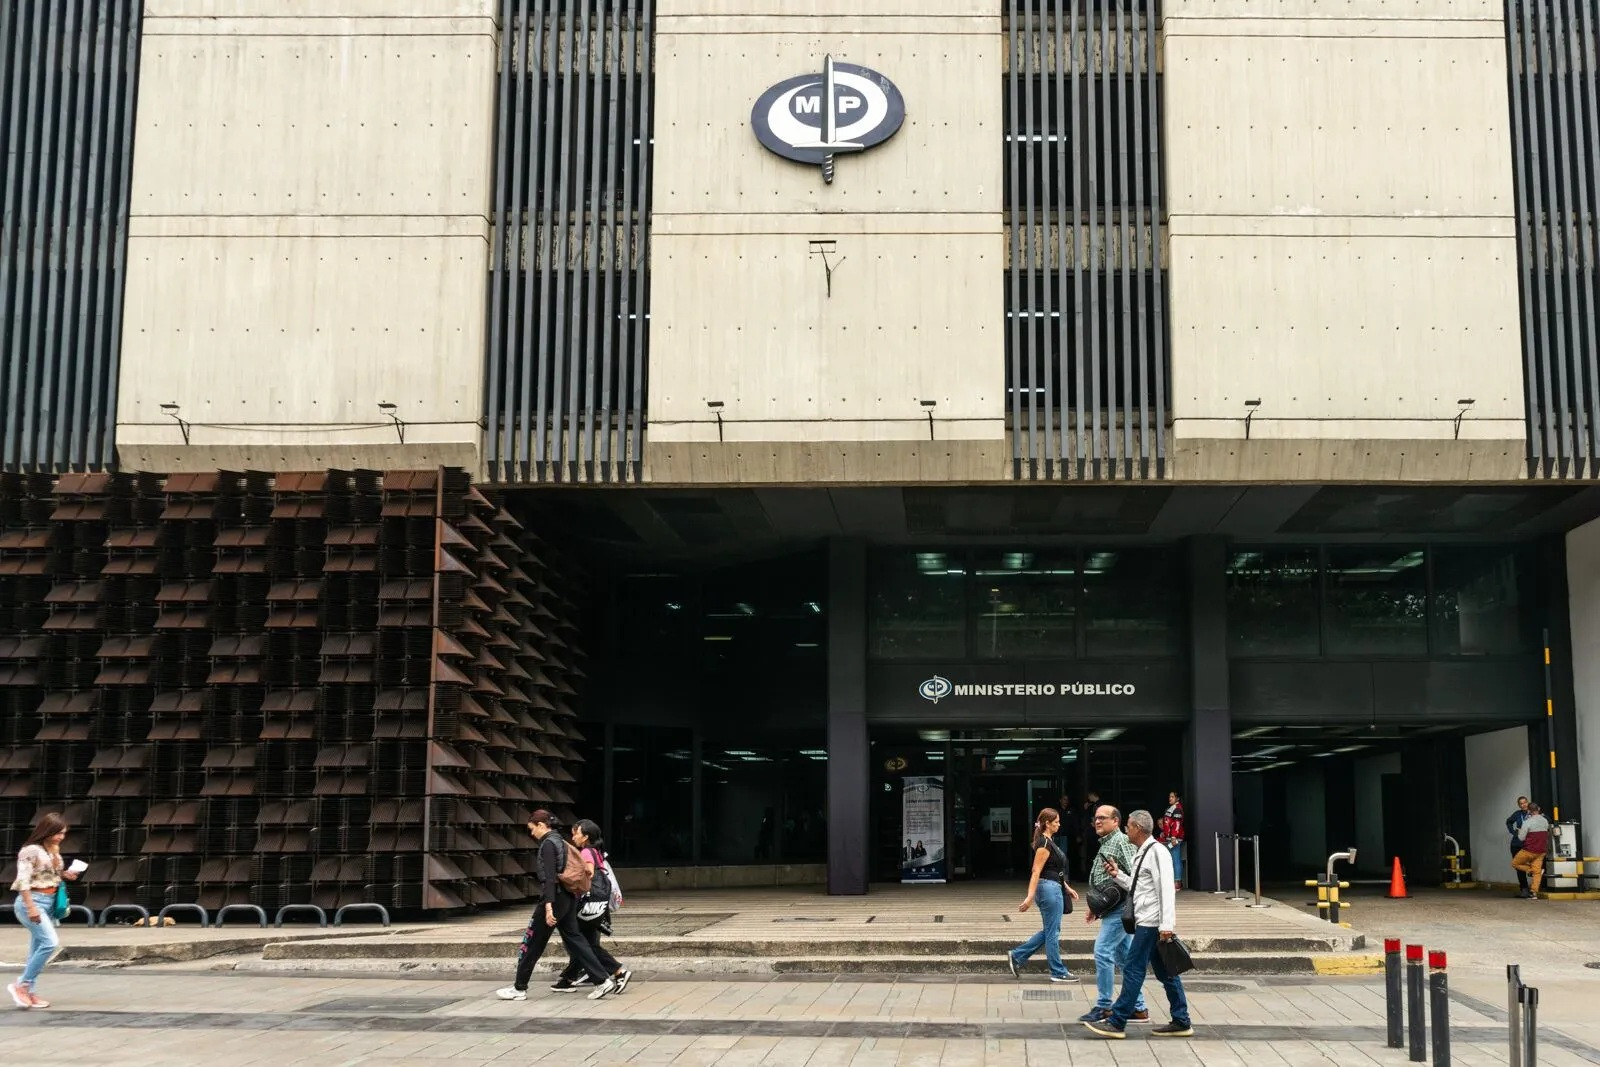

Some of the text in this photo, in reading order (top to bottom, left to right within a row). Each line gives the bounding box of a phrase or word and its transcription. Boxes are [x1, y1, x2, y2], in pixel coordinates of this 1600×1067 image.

[954, 681, 1136, 696] MINISTERIO PÚBLICO
[582, 901, 609, 914] NIKE
